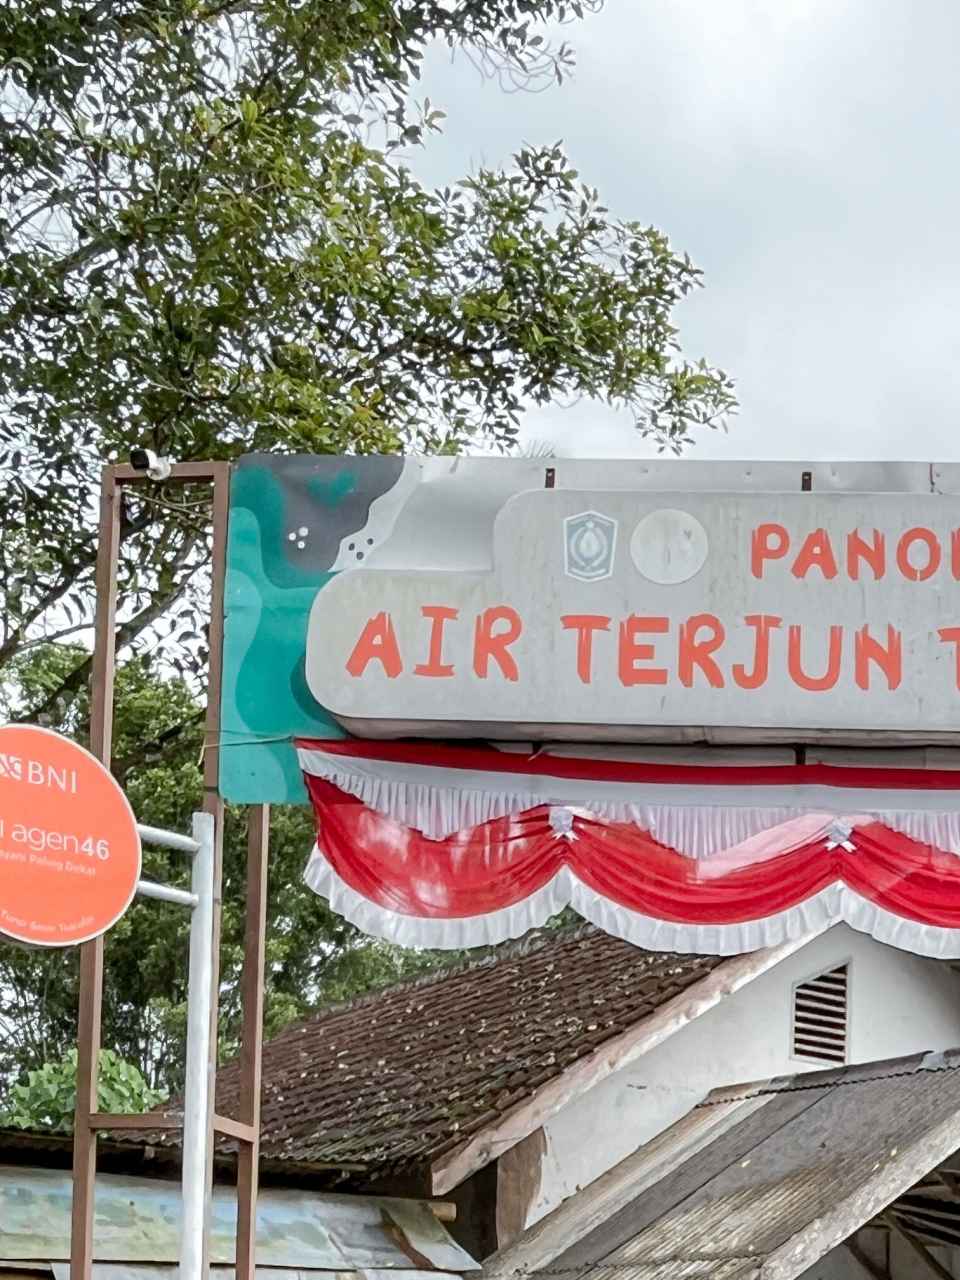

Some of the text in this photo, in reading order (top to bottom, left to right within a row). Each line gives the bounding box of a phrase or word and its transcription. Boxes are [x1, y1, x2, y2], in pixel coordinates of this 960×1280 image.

[346, 606, 521, 680] AIR
[563, 614, 902, 692] TERJUN
[28, 760, 77, 794] BNI
[11, 822, 111, 861] agen46
